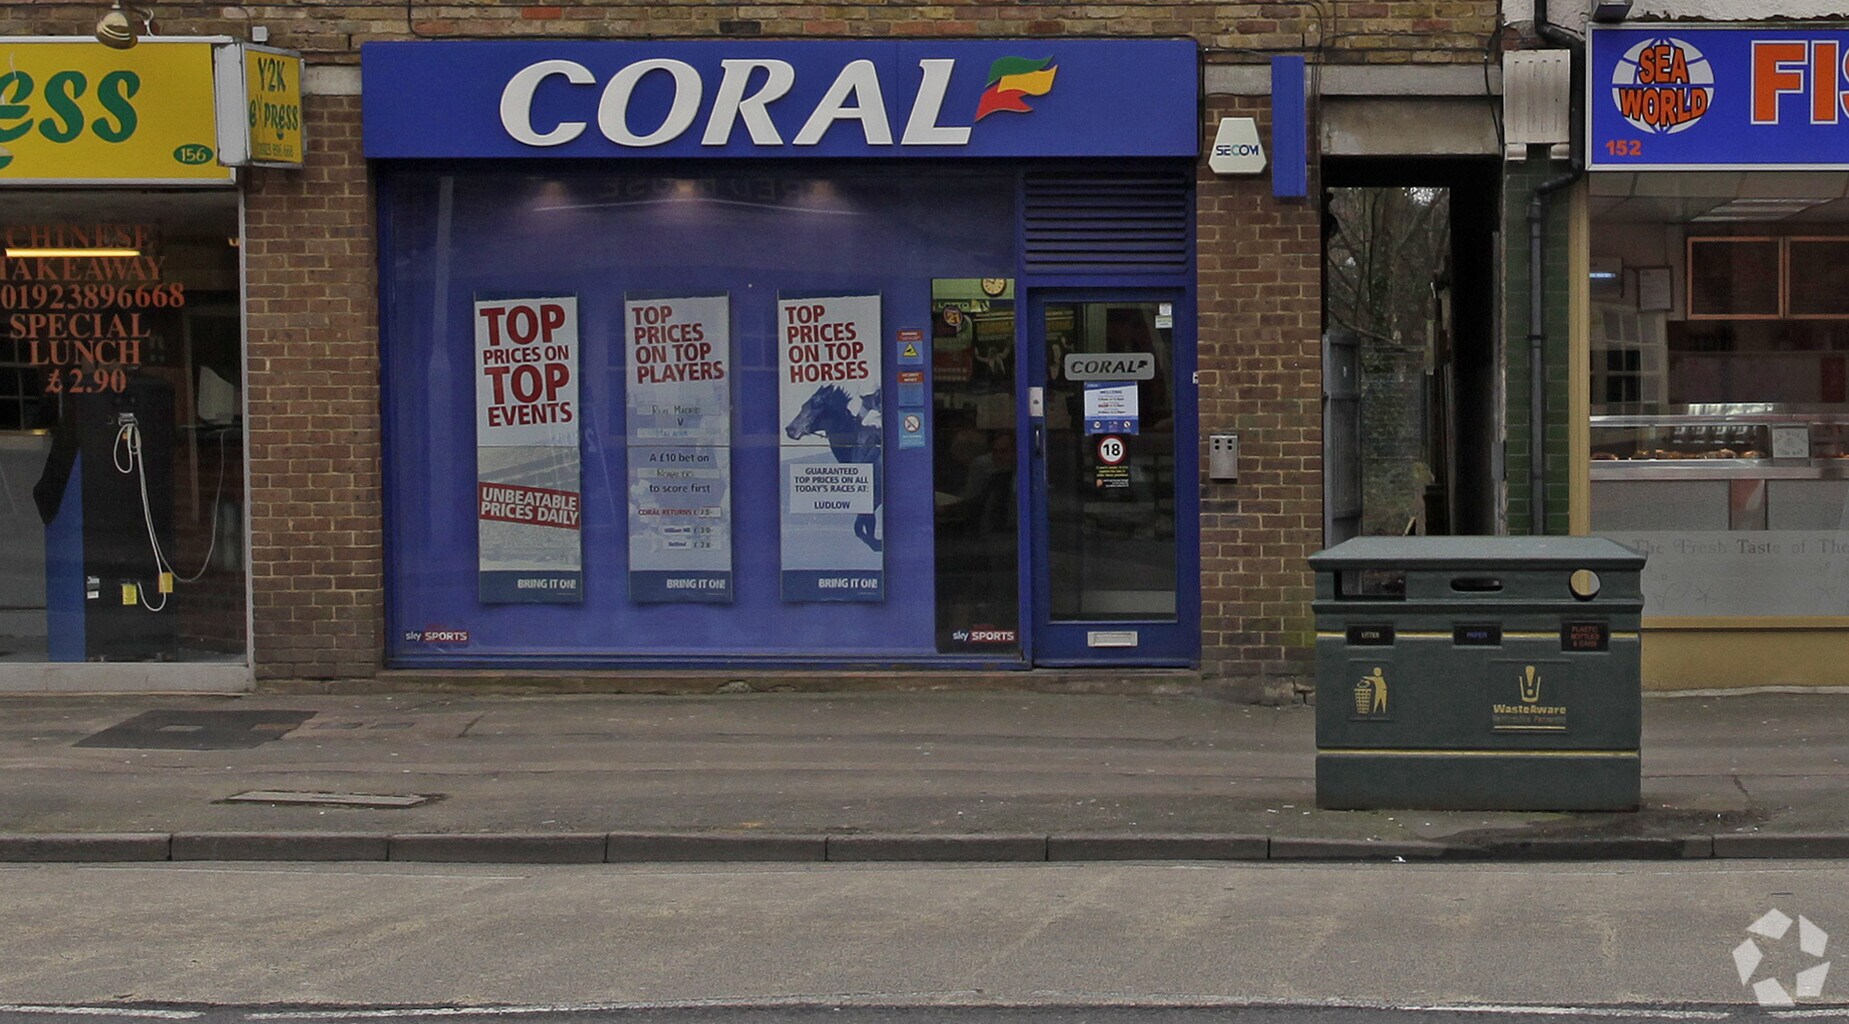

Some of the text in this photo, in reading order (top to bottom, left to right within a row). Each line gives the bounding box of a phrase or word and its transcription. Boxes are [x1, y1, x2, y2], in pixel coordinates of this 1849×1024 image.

[257, 57, 287, 92] Y2K
[1638, 44, 1690, 84] SEA
[1751, 39, 1849, 125] FI
[499, 57, 973, 147] CORAL
[1619, 87, 1709, 127] WORLD
[180, 146, 206, 162] 156
[1215, 144, 1259, 156] SECOM
[1605, 139, 1642, 156] 152
[6, 225, 156, 253] CHINESE
[0, 255, 165, 281] TAKEAWAY
[1, 282, 186, 310] 01923896668
[631, 305, 673, 326] TOP
[785, 304, 826, 325] TOP
[9, 312, 151, 339] SPECIAL
[479, 304, 565, 347] TOP
[634, 323, 704, 345] PRICES
[787, 322, 857, 344] PRICES
[29, 339, 142, 366] LUNCH
[482, 345, 569, 365] PRICES ON
[635, 342, 712, 364] ON TOP
[788, 341, 864, 363] ON TOP
[637, 360, 725, 384] PLAYERS
[790, 360, 869, 384] HORSES
[1070, 360, 1137, 374] CORAL
[484, 362, 570, 405] TOP
[488, 402, 573, 427] EVENTS
[649, 453, 657, 462] A
[659, 453, 676, 462] £10
[678, 453, 694, 462] bet
[1103, 443, 1121, 456] 18
[794, 476, 869, 484] TOP PRICES ON ALL
[805, 467, 859, 475] GUARANTEED
[482, 486, 577, 511] UNBEATABLE
[649, 483, 711, 493] to score first
[794, 484, 869, 493] TODAY'S RACES AT:
[480, 502, 580, 526] PRICES DAILY
[638, 508, 660, 516] CORAL
[814, 501, 851, 510] LUDLOW
[1736, 538, 1780, 554] Taste
[1792, 538, 1808, 554] of
[517, 578, 548, 589] BRING
[549, 578, 558, 589] IT
[666, 578, 697, 589] BRING
[698, 578, 708, 589] IT
[818, 578, 849, 588] BRING
[850, 578, 859, 588] IT
[405, 631, 468, 642] sky SPORTS
[952, 631, 1015, 642] sky SPORTS
[1361, 631, 1380, 639] LITTER
[1466, 631, 1488, 639] PAPER
[1492, 704, 1567, 714] WasteAware
